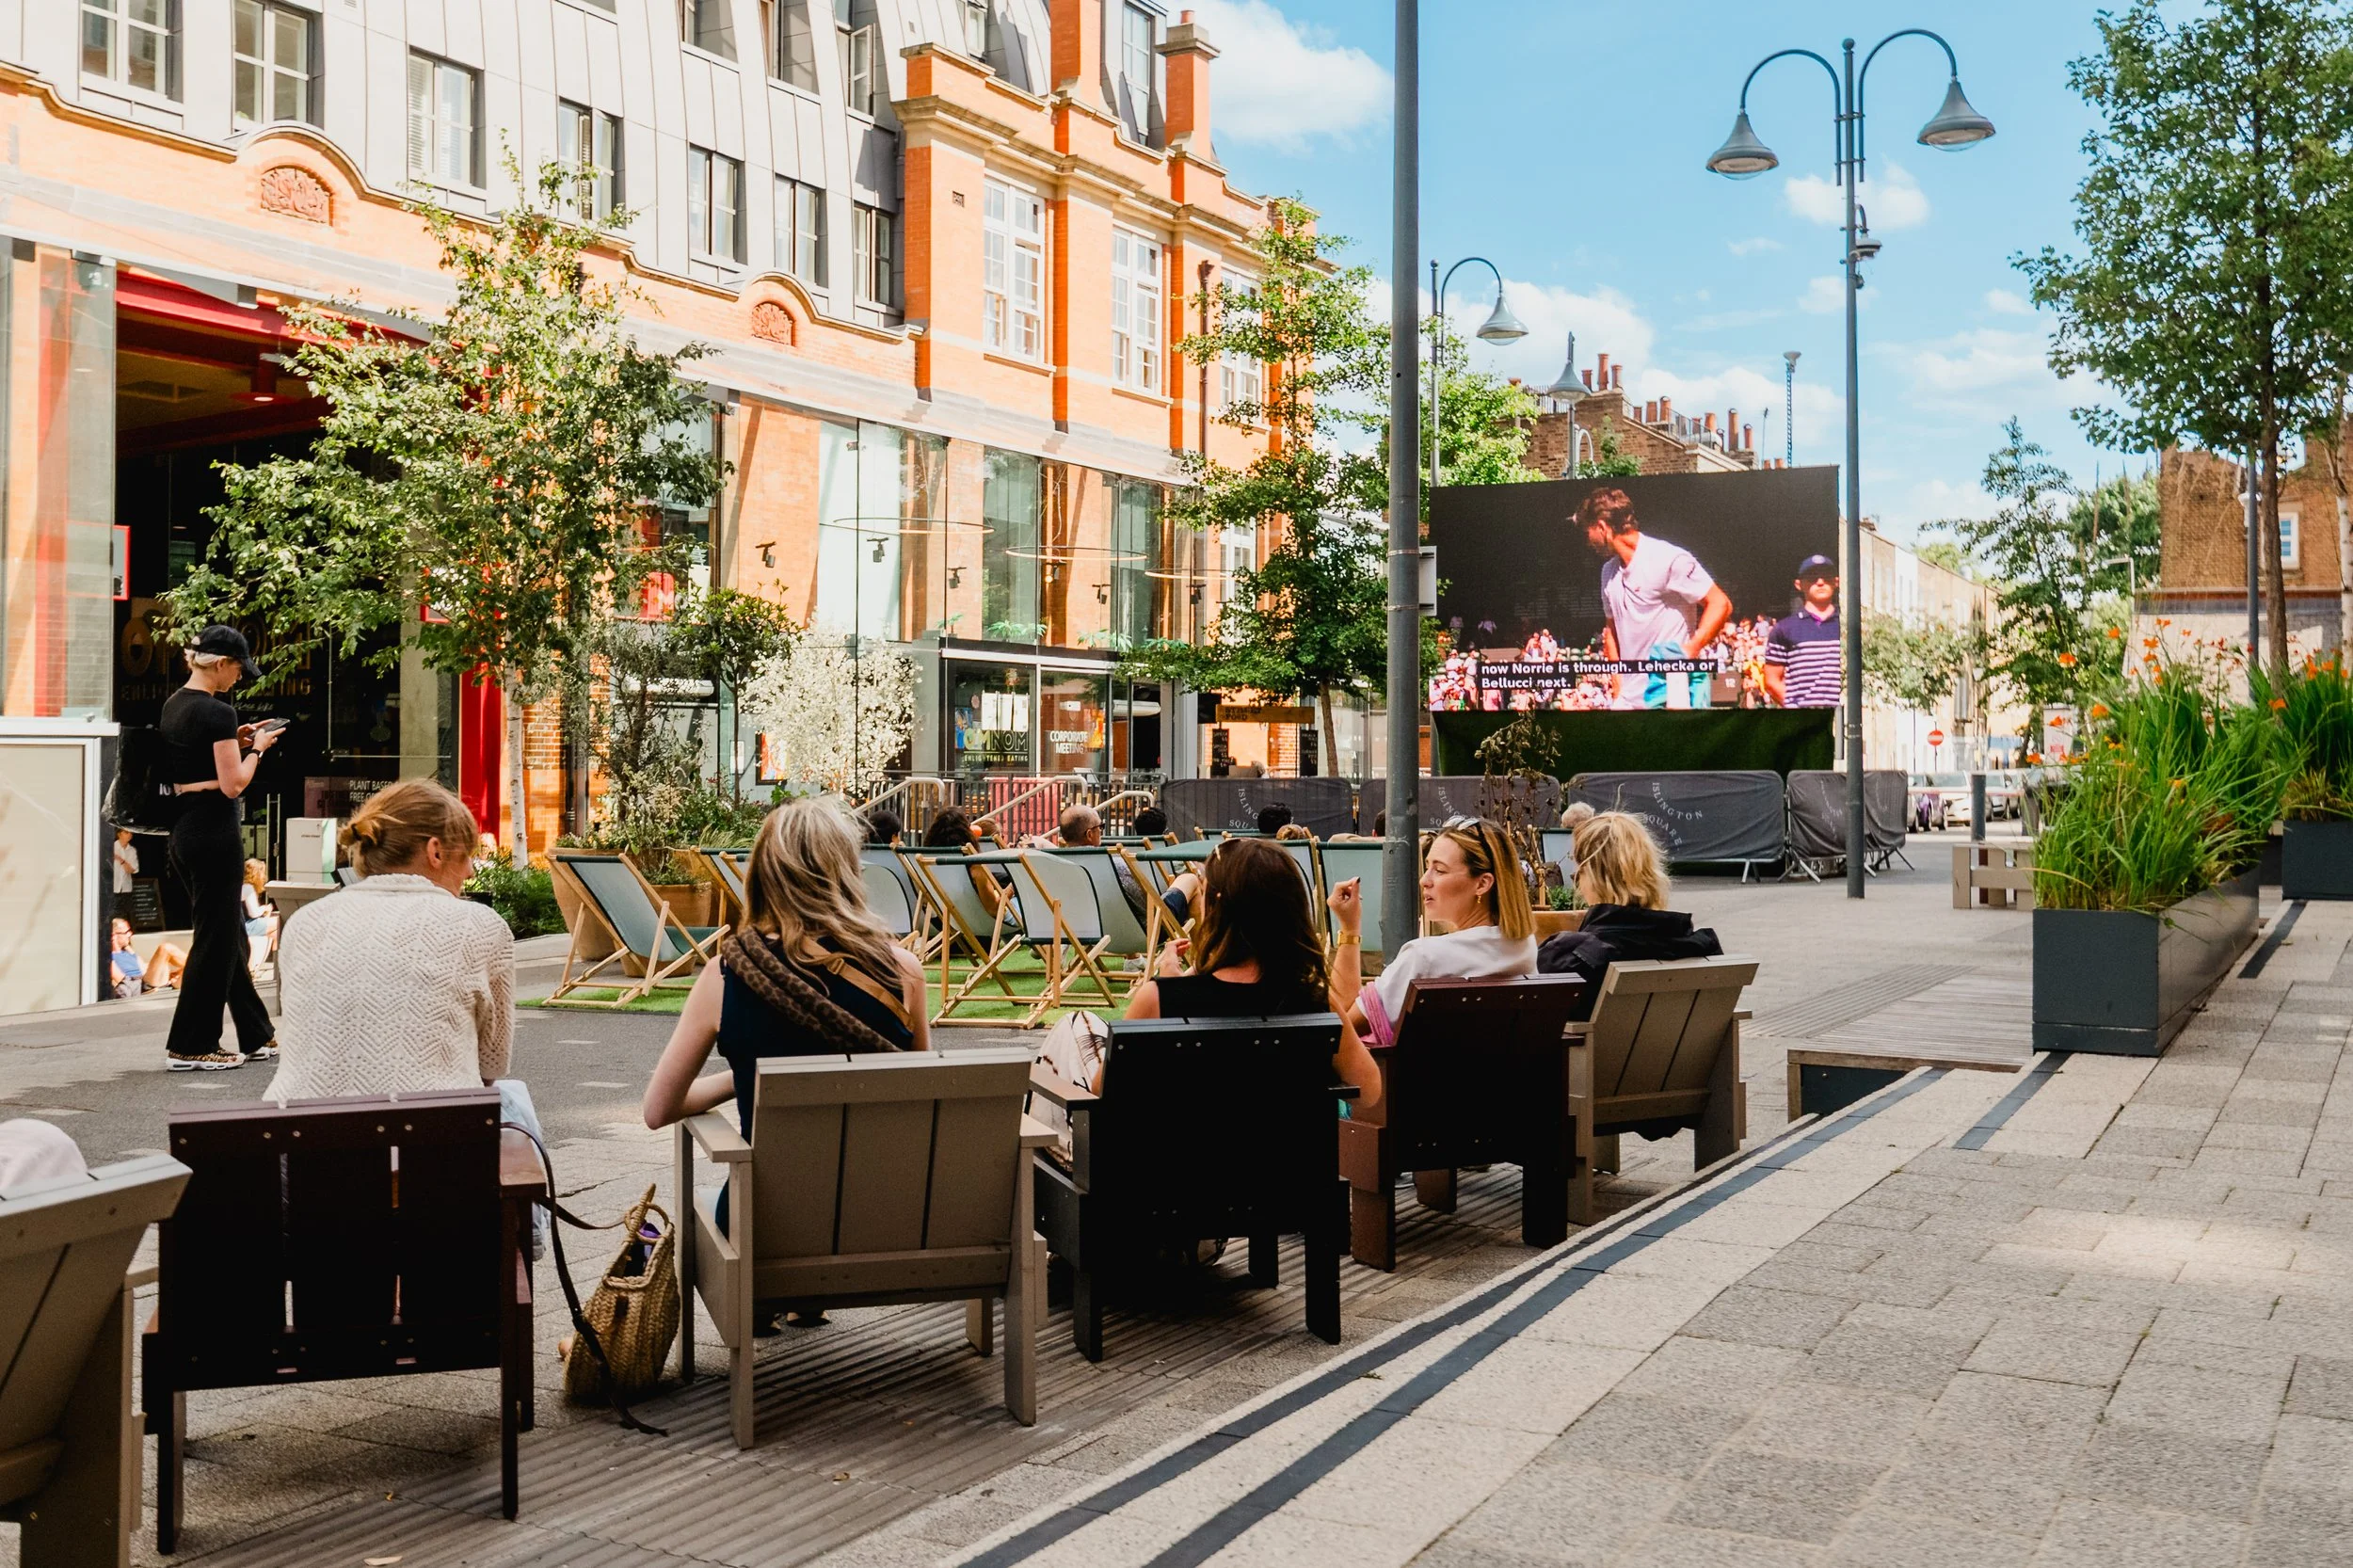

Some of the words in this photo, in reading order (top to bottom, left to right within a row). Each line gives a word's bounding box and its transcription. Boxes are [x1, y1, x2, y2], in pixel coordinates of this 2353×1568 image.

[1481, 664, 1508, 674] now
[1513, 663, 1553, 674] Norrie
[1559, 663, 1570, 673] is
[1574, 662, 1632, 675] through.
[1638, 661, 1695, 672] Lehecka
[1699, 662, 1715, 671] or
[1481, 678, 1532, 689] Bellucci
[1537, 678, 1571, 688] next.
[1049, 730, 1088, 742] CORPORATE
[1055, 743, 1084, 754] MEETING
[349, 780, 371, 791] PLANT
[349, 792, 364, 803] FREE
[1652, 782, 1703, 821] ISLINGTON
